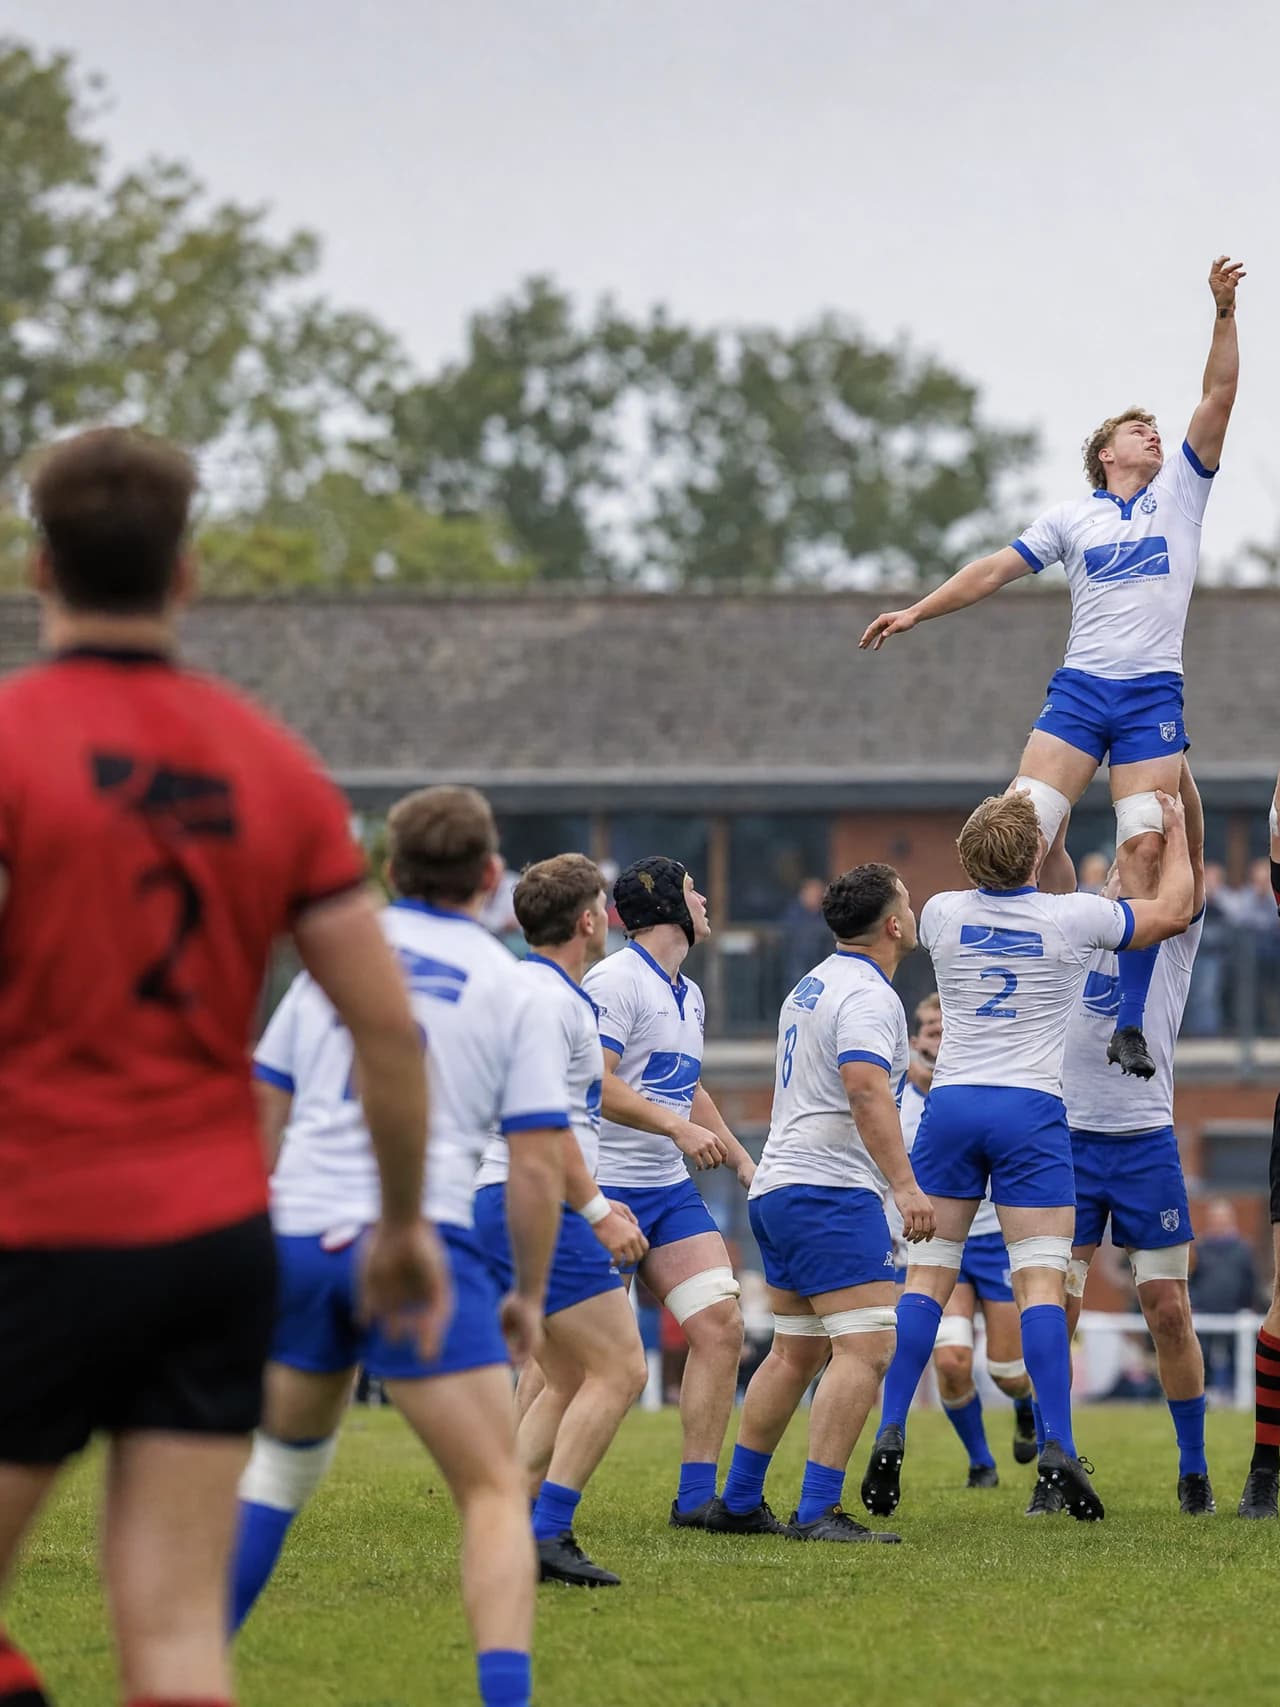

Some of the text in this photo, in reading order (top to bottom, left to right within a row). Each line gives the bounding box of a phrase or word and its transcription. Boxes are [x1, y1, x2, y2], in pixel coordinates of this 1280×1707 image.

[134, 860, 203, 1012] 2
[975, 968, 1018, 1018] 2
[782, 1023, 797, 1088] 8
